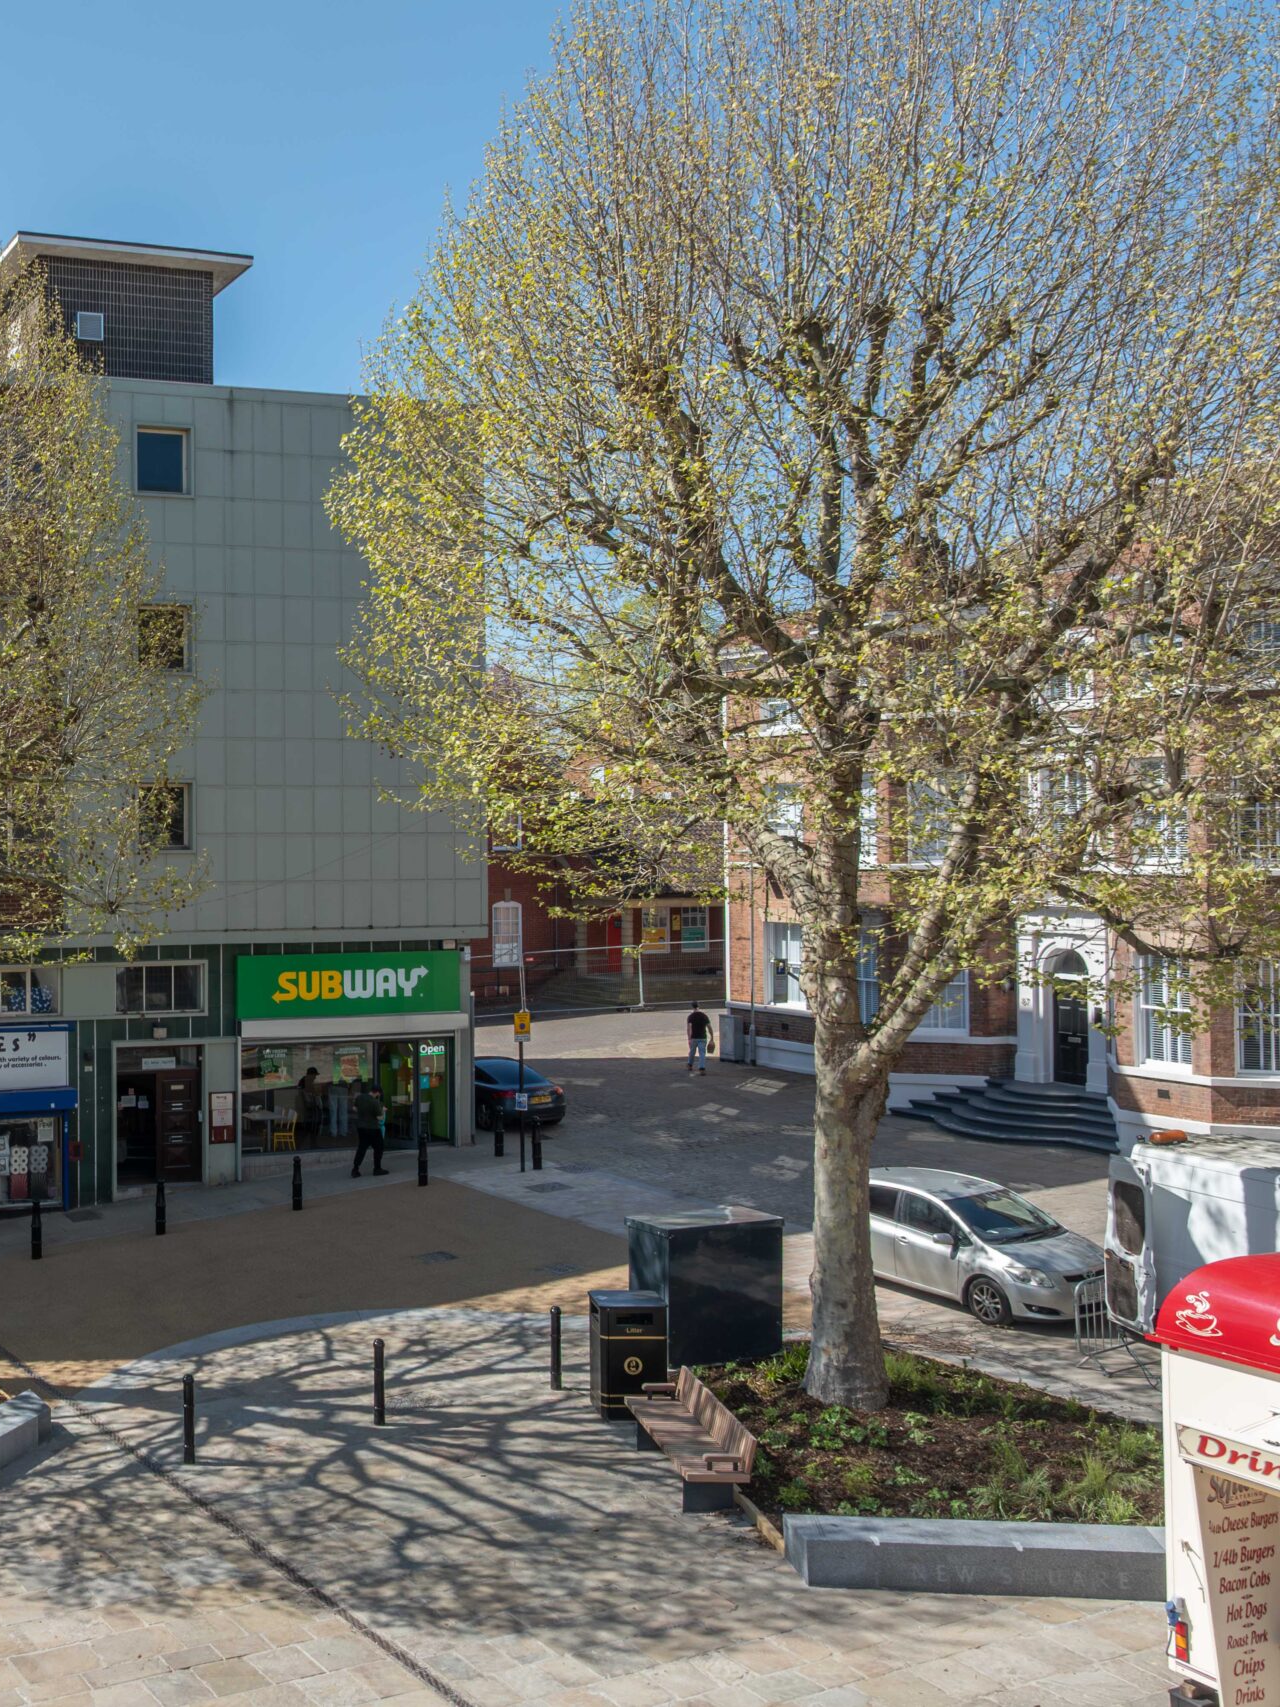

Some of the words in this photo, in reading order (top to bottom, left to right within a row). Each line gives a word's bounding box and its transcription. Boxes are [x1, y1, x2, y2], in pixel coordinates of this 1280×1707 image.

[272, 965, 429, 1004] SUBWAY
[419, 1045, 445, 1056] Open
[1222, 1516, 1249, 1533] Cheese
[1250, 1511, 1279, 1529] Burgers
[1213, 1548, 1238, 1568] 1/4lb
[1240, 1544, 1275, 1563] Burgers
[1219, 1576, 1247, 1595] Bacon
[1249, 1569, 1272, 1589] Cobs
[1226, 1603, 1244, 1624] Hot
[1245, 1601, 1268, 1620] Dogs
[1226, 1633, 1250, 1650] Roast
[1251, 1628, 1269, 1646] Pork
[1233, 1657, 1266, 1677] Chips
[1235, 1685, 1266, 1706] Drinks
